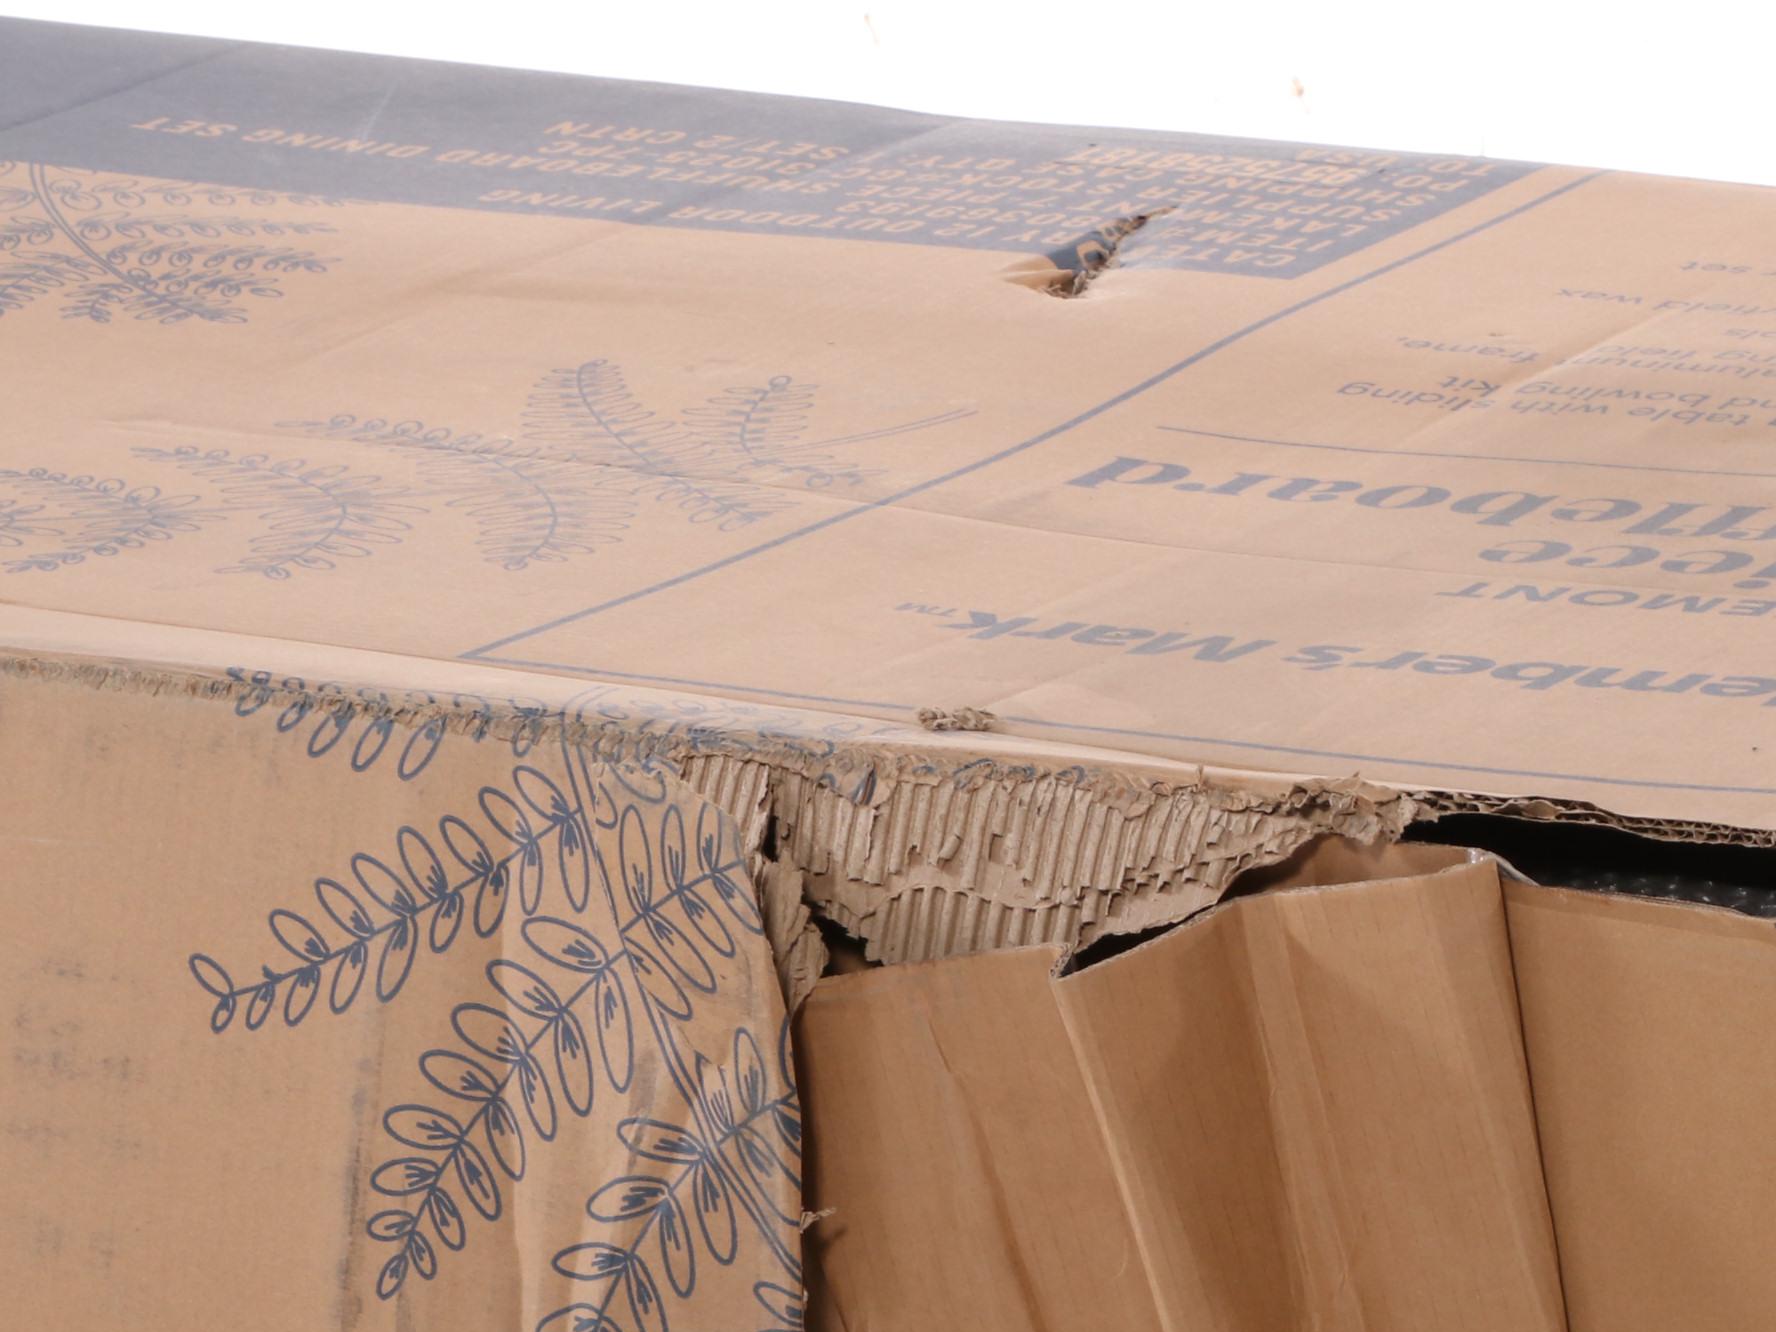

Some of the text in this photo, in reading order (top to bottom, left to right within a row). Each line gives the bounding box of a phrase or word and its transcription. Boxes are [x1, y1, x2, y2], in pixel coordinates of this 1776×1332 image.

[134, 116, 240, 138] SET
[544, 120, 687, 144] CRTN
[245, 128, 432, 158] DINING
[1034, 161, 1166, 180] CASE
[1296, 148, 1402, 169] USA
[434, 148, 840, 194] SHUFFLEBOARD
[1382, 173, 1467, 192] PO:
[479, 188, 664, 214] LIVING
[845, 182, 1062, 209] 7-PIECE
[1173, 172, 1434, 208] SHIPPING
[1136, 184, 1404, 223] SUPPLIER
[672, 207, 926, 233] OUTDOOR
[935, 221, 997, 240] 12
[1152, 227, 1335, 251] ITEM#
[1680, 259, 1752, 273] set
[1559, 288, 1644, 305] wax
[1335, 380, 1495, 412] sliding
[1437, 374, 1503, 399] kit
[1512, 379, 1711, 408] bowling
[1506, 399, 1609, 416] with
[1627, 406, 1751, 428] table
